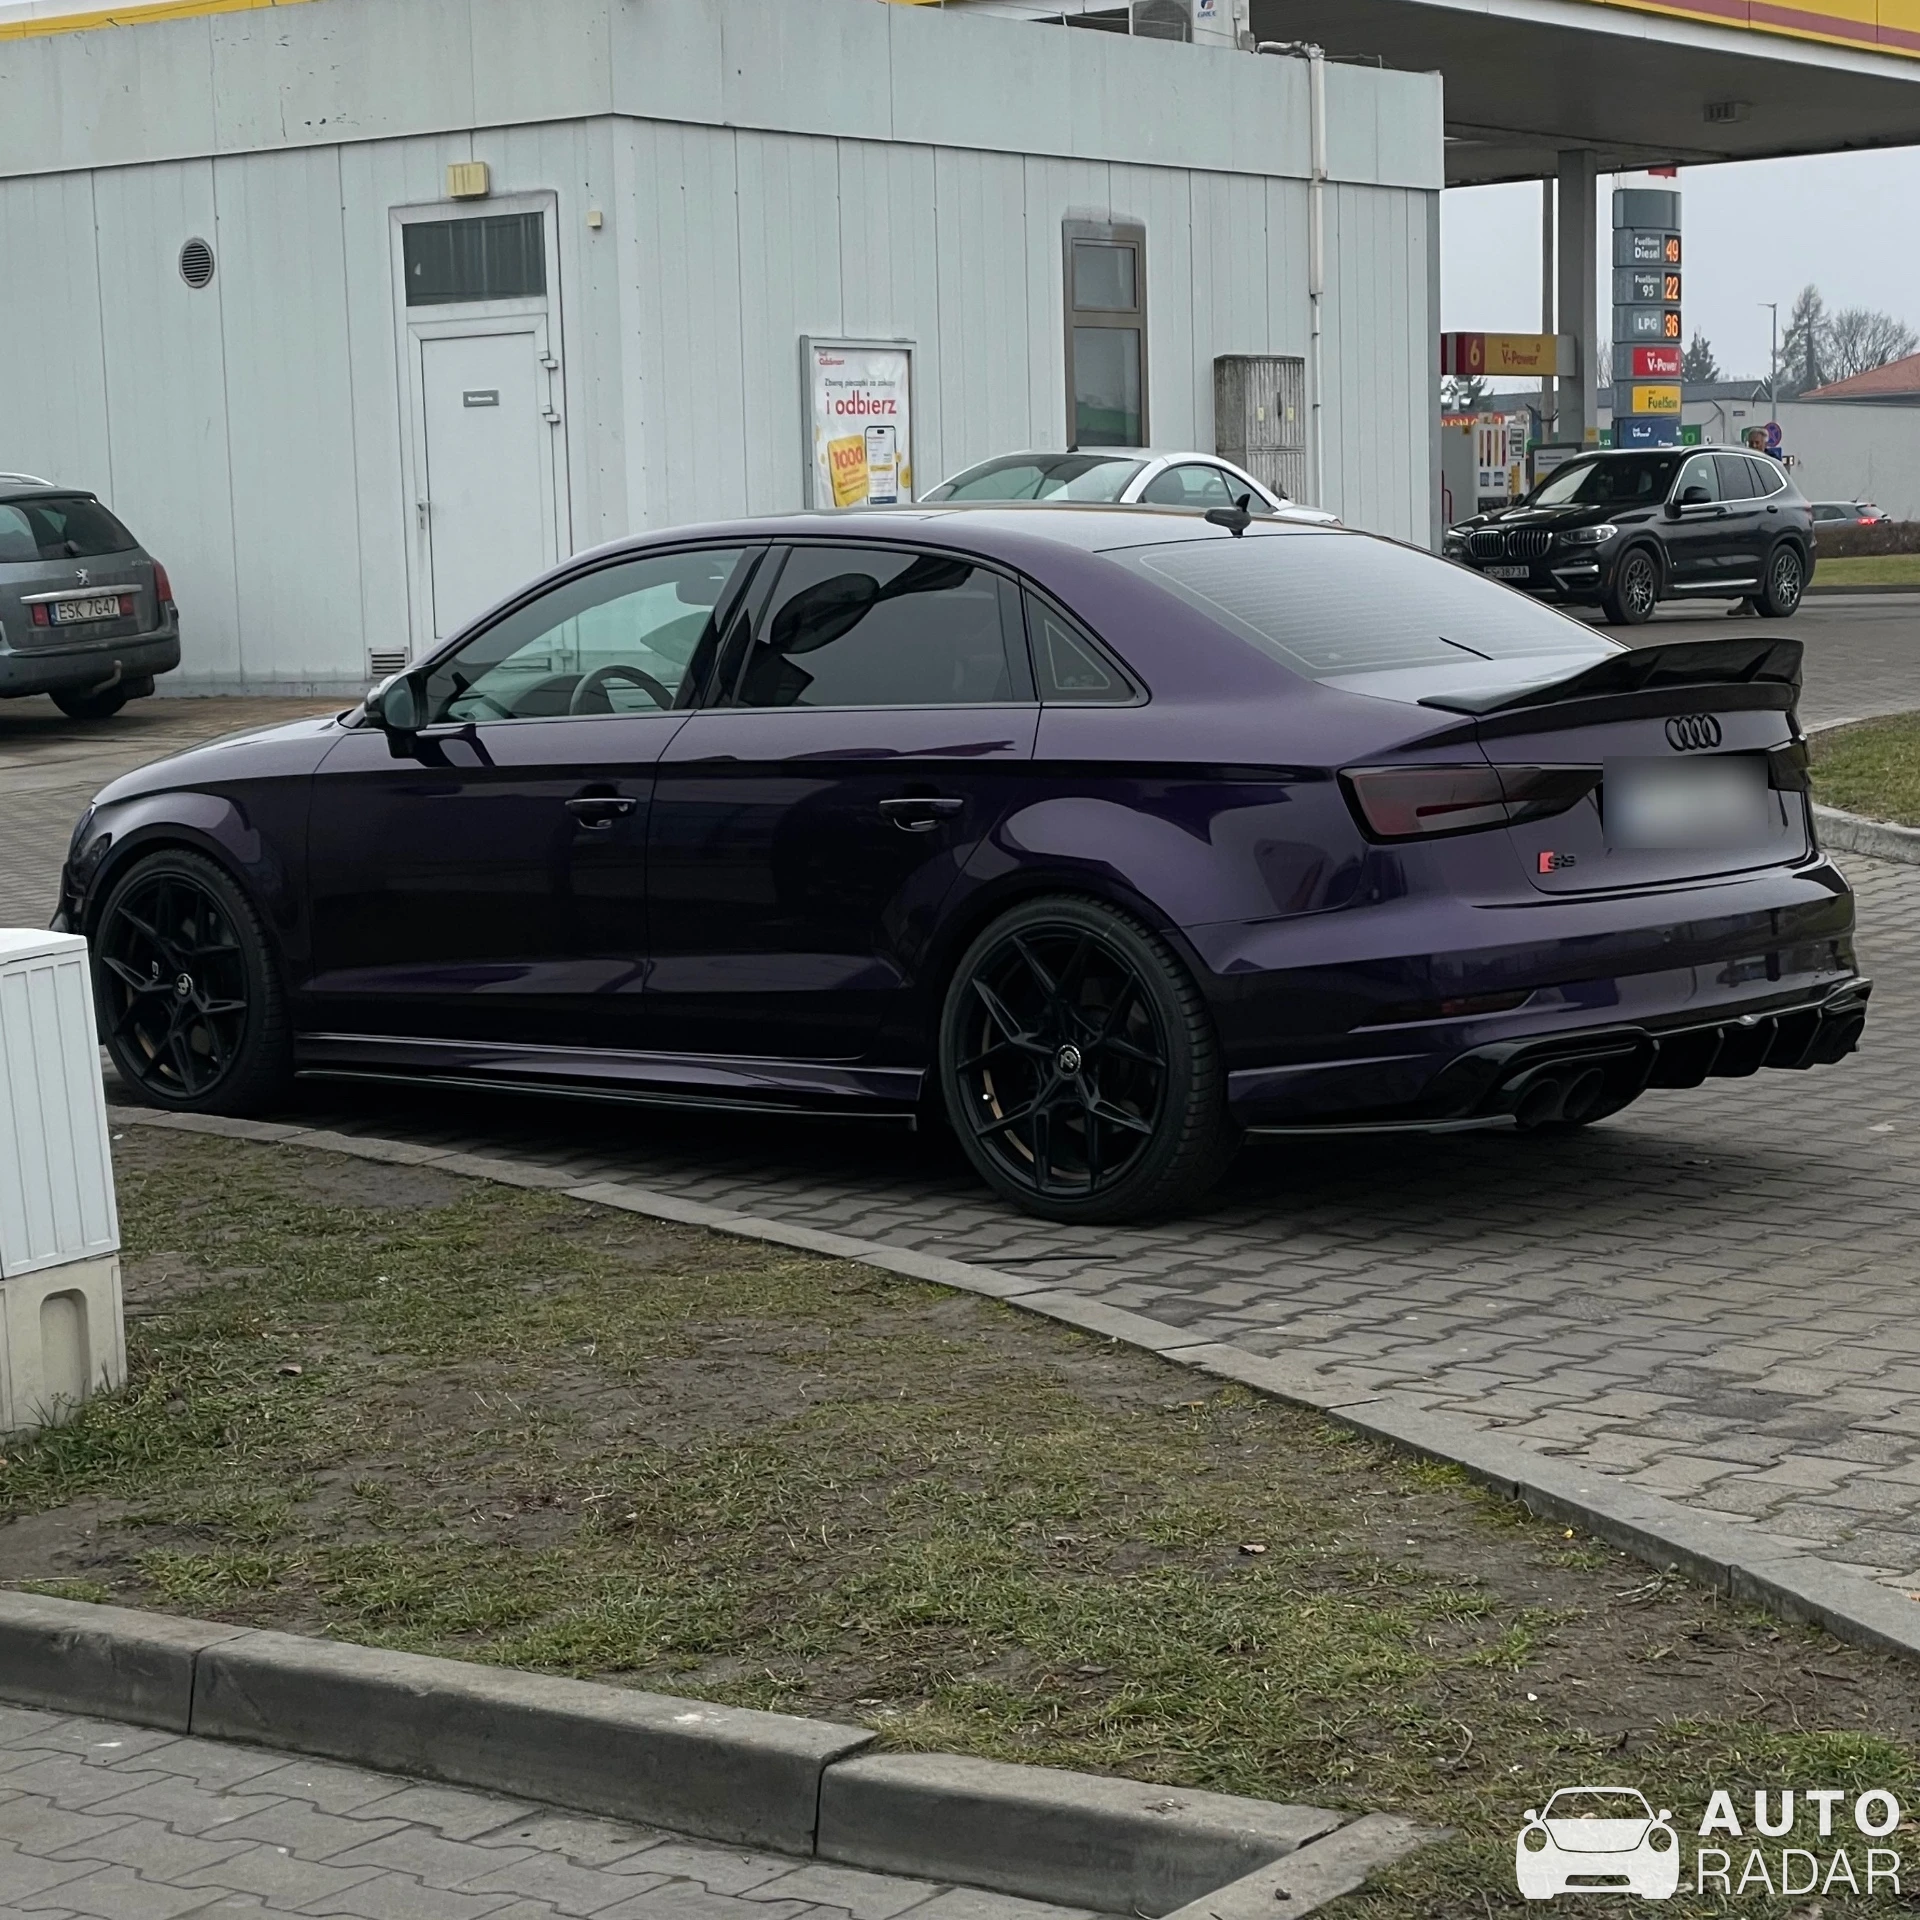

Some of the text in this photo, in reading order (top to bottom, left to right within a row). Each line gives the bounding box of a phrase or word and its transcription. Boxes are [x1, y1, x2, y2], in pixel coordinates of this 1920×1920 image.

[1634, 239, 1679, 262] Diesel 49
[1642, 276, 1679, 300] 95 22
[1638, 314, 1679, 337] LPG 36
[1469, 339, 1538, 366] 6 V-Power
[1647, 358, 1678, 372] V-Power
[826, 389, 897, 415] i odbierz
[833, 445, 863, 471] 1000
[59, 598, 116, 620] ESK 7G47
